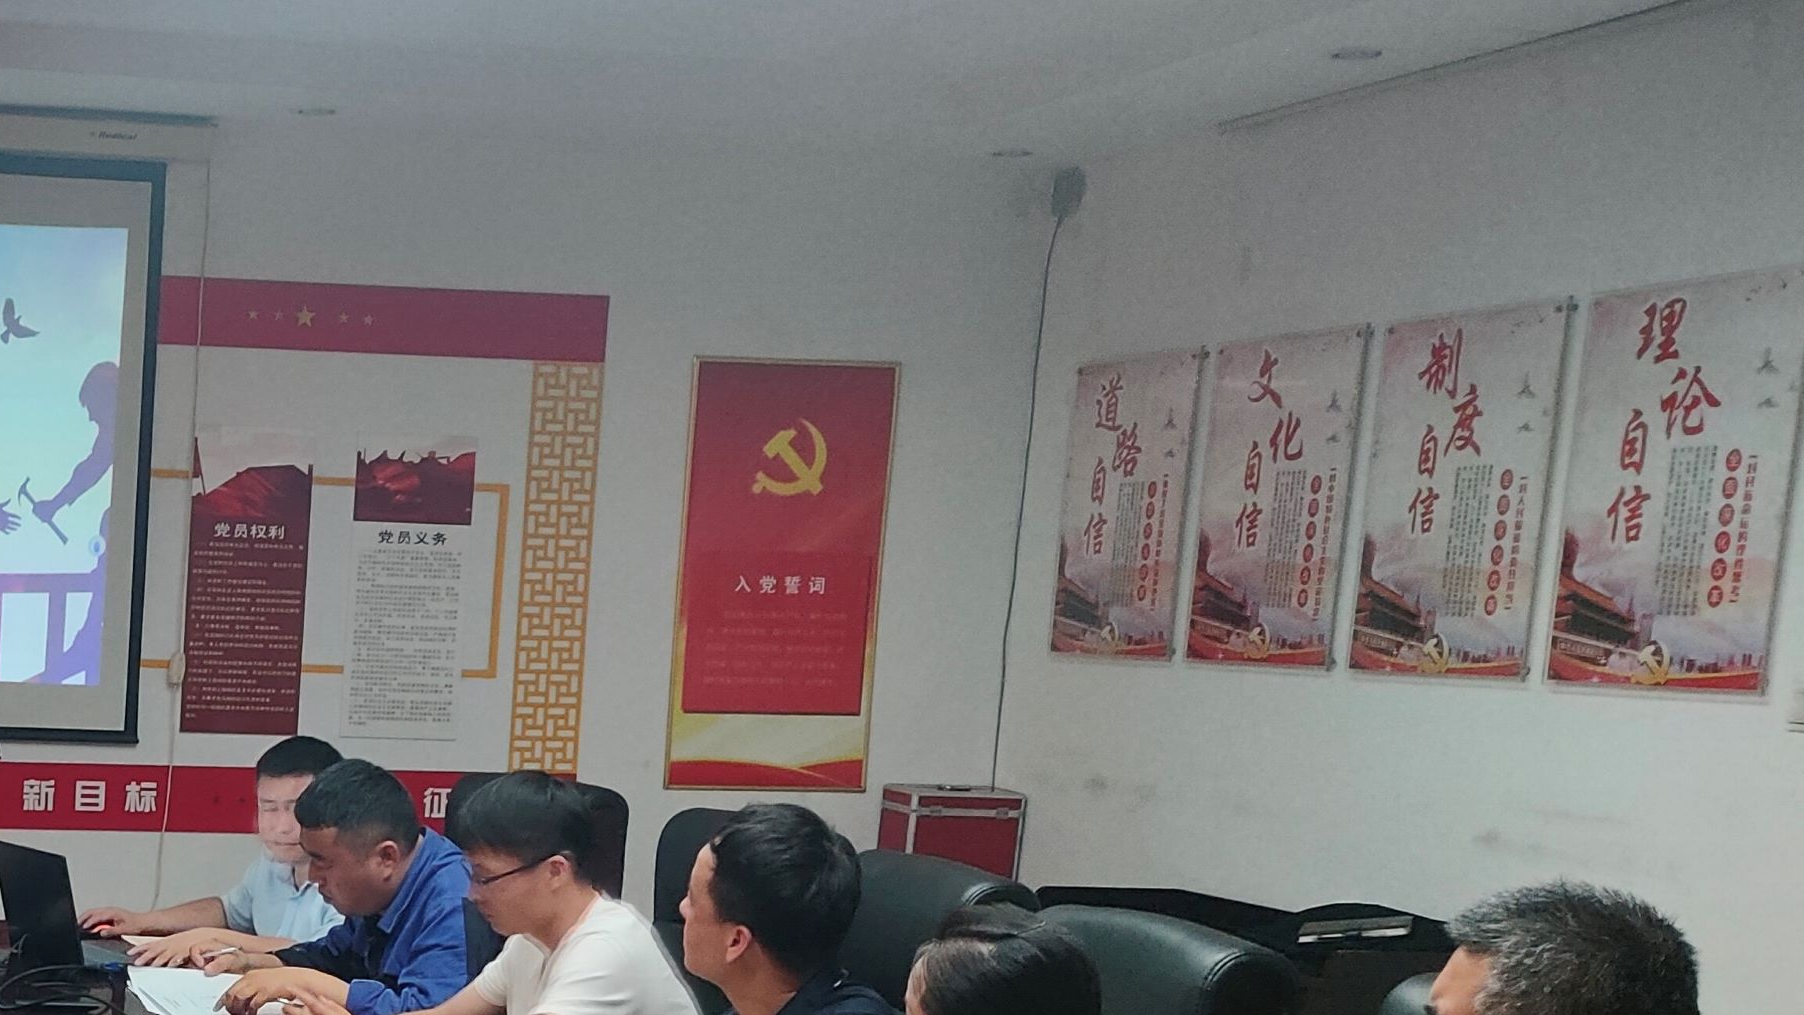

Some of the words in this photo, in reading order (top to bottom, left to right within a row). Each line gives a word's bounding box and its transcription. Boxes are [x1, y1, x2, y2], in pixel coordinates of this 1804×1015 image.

[1248, 349, 1303, 464] 文化
[1637, 298, 1721, 439] 理论
[1084, 456, 1108, 556] 自信
[1235, 440, 1263, 548] 自信
[1408, 424, 1440, 534] 自信
[1607, 408, 1651, 544] 自信
[214, 523, 285, 540] 党员权利
[377, 529, 448, 546] 党员义务
[734, 575, 826, 595] 入党誓词
[22, 778, 157, 814] 新目标
